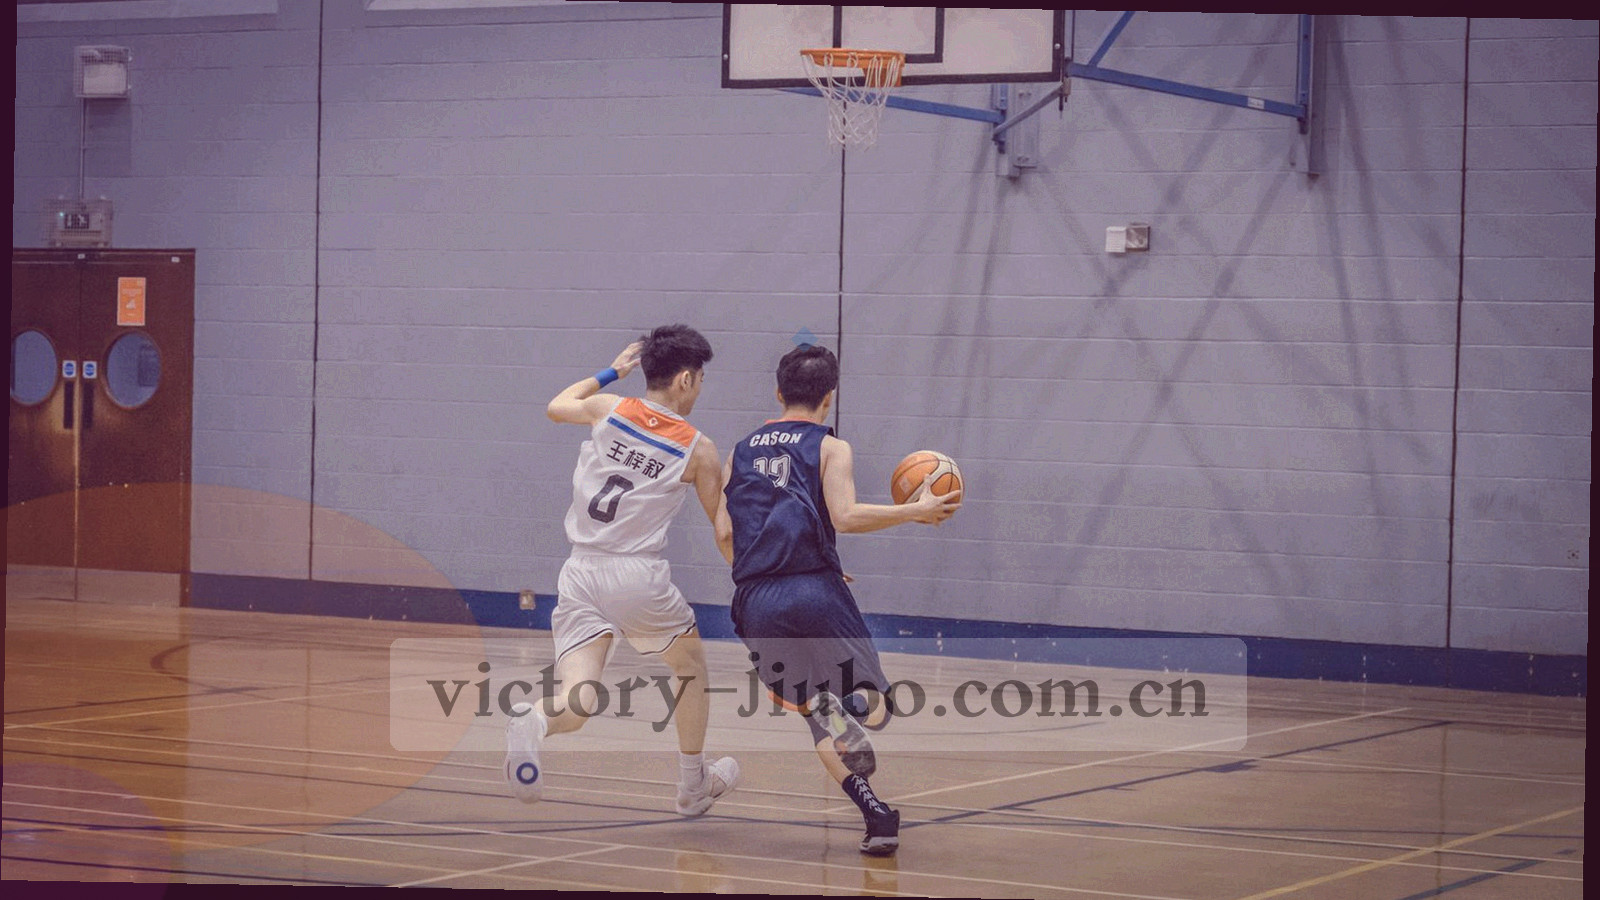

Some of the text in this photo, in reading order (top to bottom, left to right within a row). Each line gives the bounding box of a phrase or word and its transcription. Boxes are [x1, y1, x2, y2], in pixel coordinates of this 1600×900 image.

[606, 439, 666, 480] 王梓叙
[749, 431, 802, 447] CASON
[587, 474, 635, 524] 0
